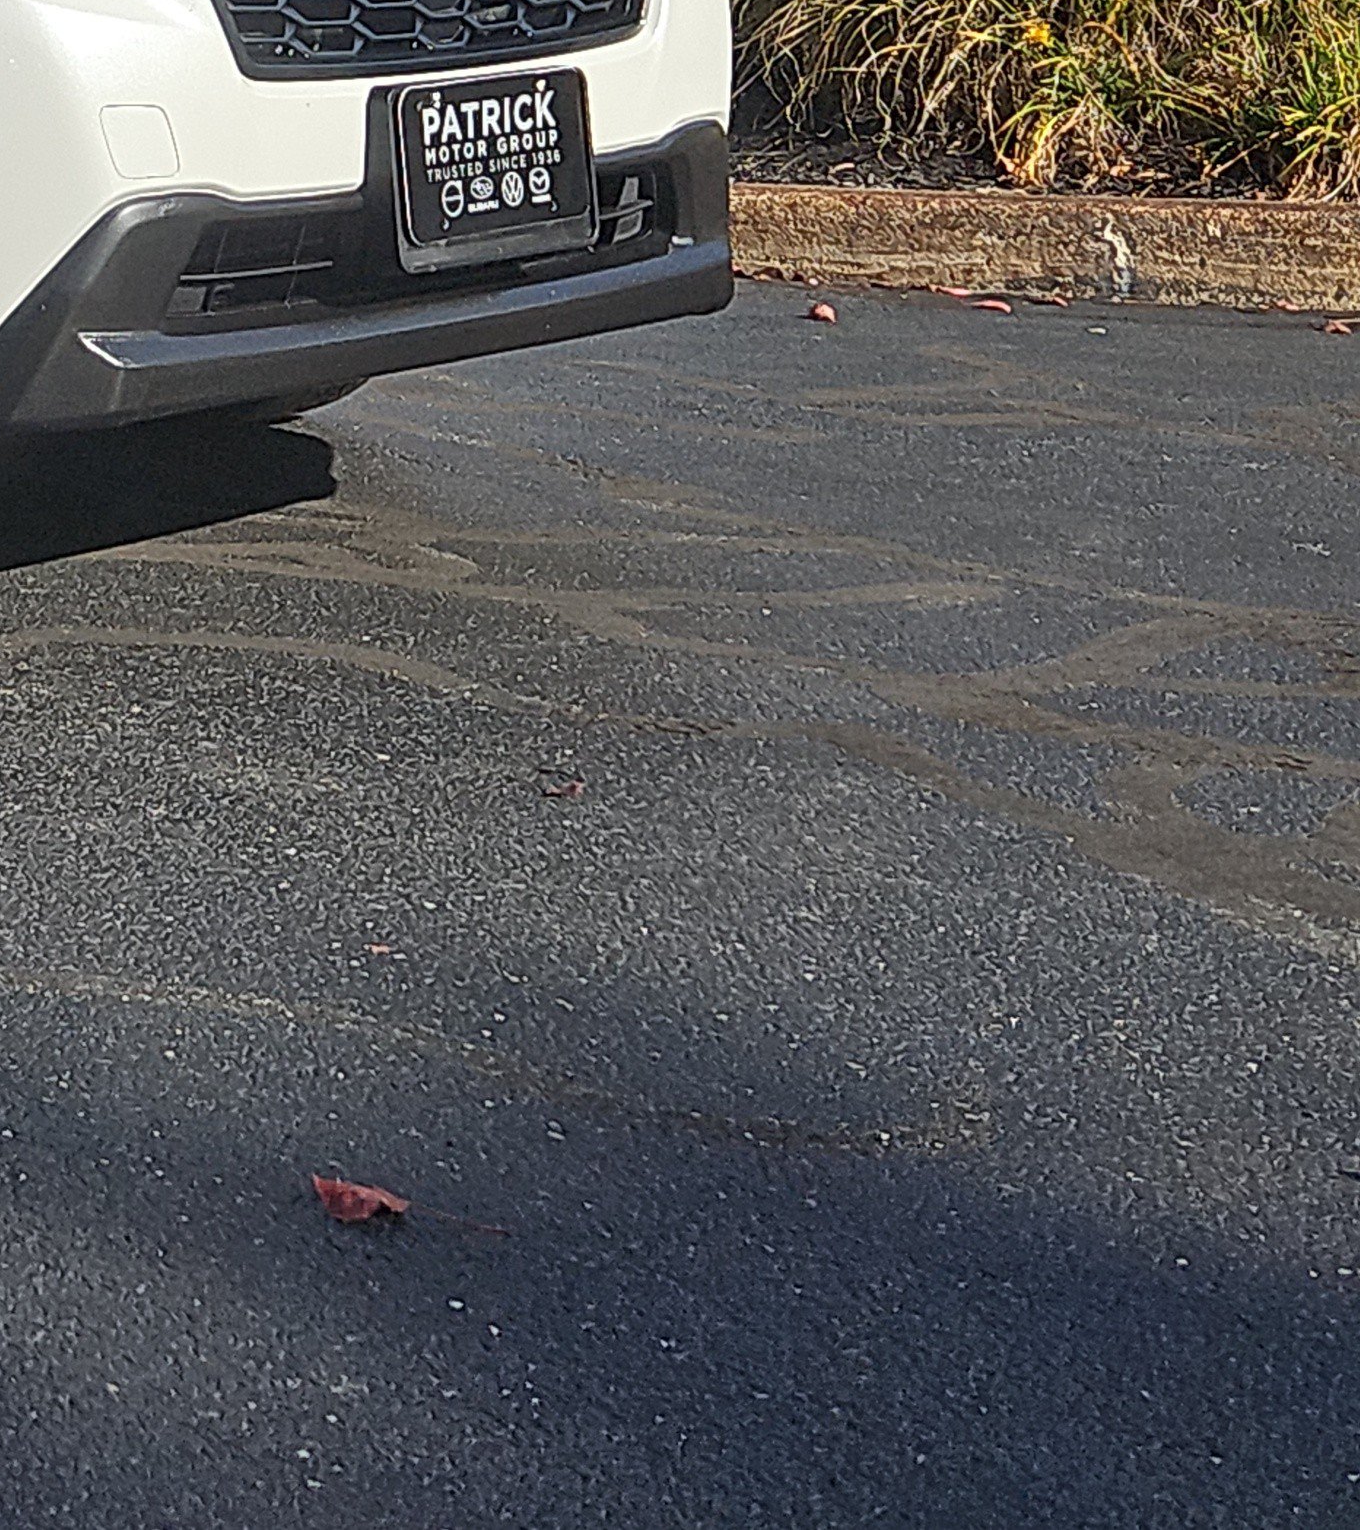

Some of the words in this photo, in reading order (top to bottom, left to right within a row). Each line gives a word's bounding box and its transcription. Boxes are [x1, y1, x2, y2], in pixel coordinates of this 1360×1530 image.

[422, 90, 557, 146] PATRICK
[424, 140, 488, 167] MOTOR
[496, 130, 559, 155] GROUP
[426, 163, 483, 183] TRUSTED
[489, 156, 528, 173] SINCE
[532, 149, 562, 166] 1936
